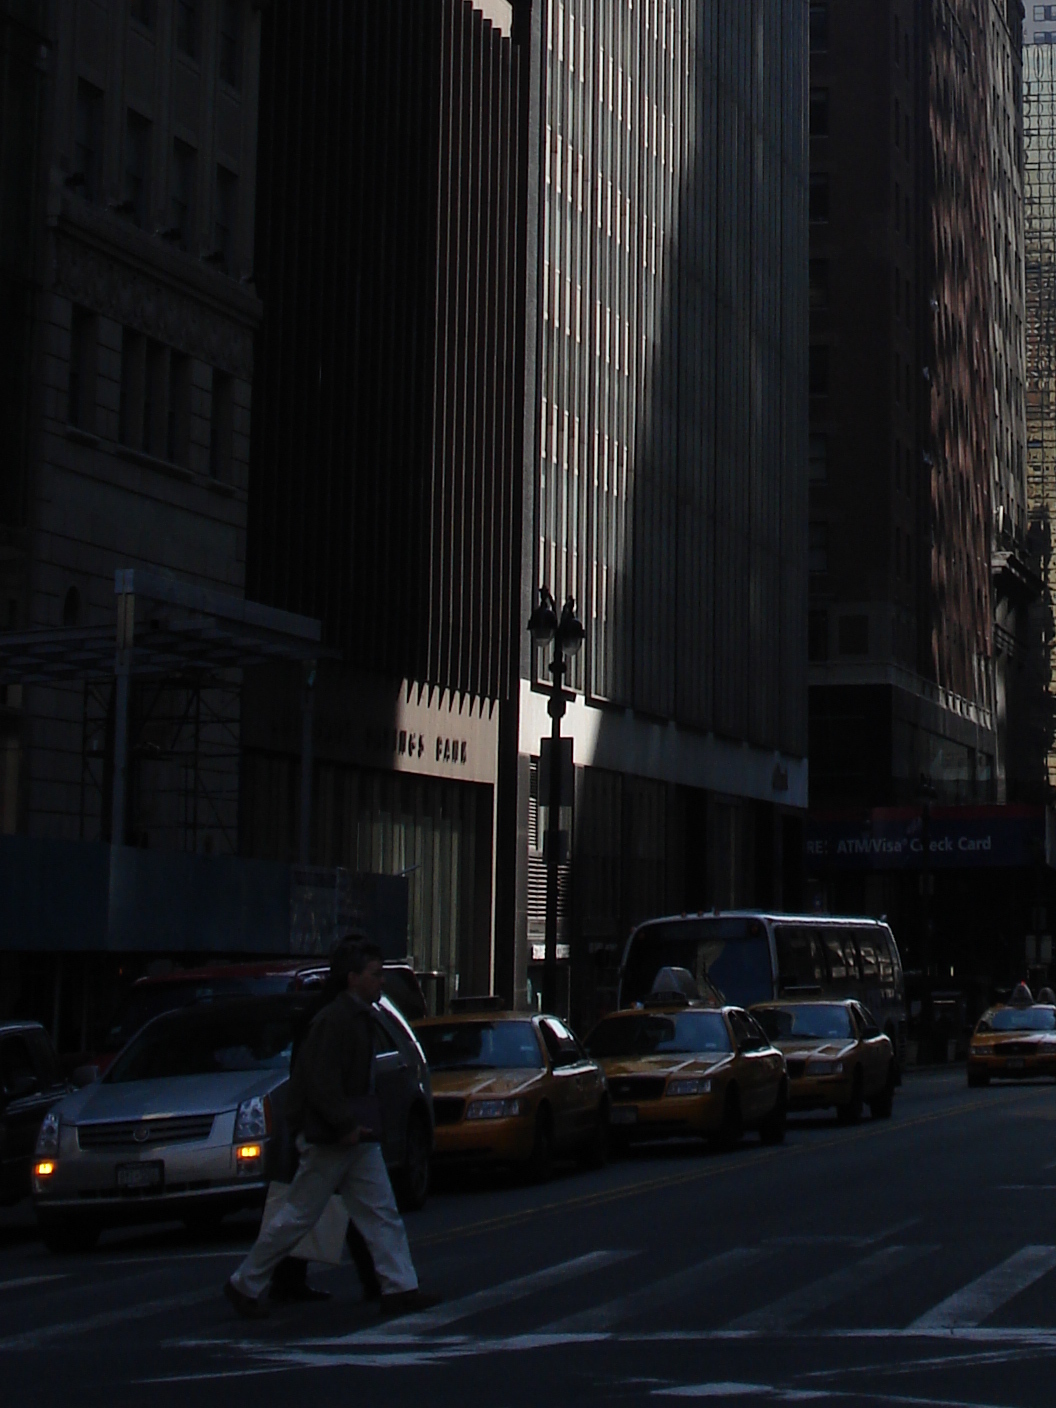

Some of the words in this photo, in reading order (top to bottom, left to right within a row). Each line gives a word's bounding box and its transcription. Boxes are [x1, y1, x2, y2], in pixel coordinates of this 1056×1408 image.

[435, 735, 467, 765] BANK
[910, 836, 953, 852] Ceck
[957, 835, 992, 851] Card
